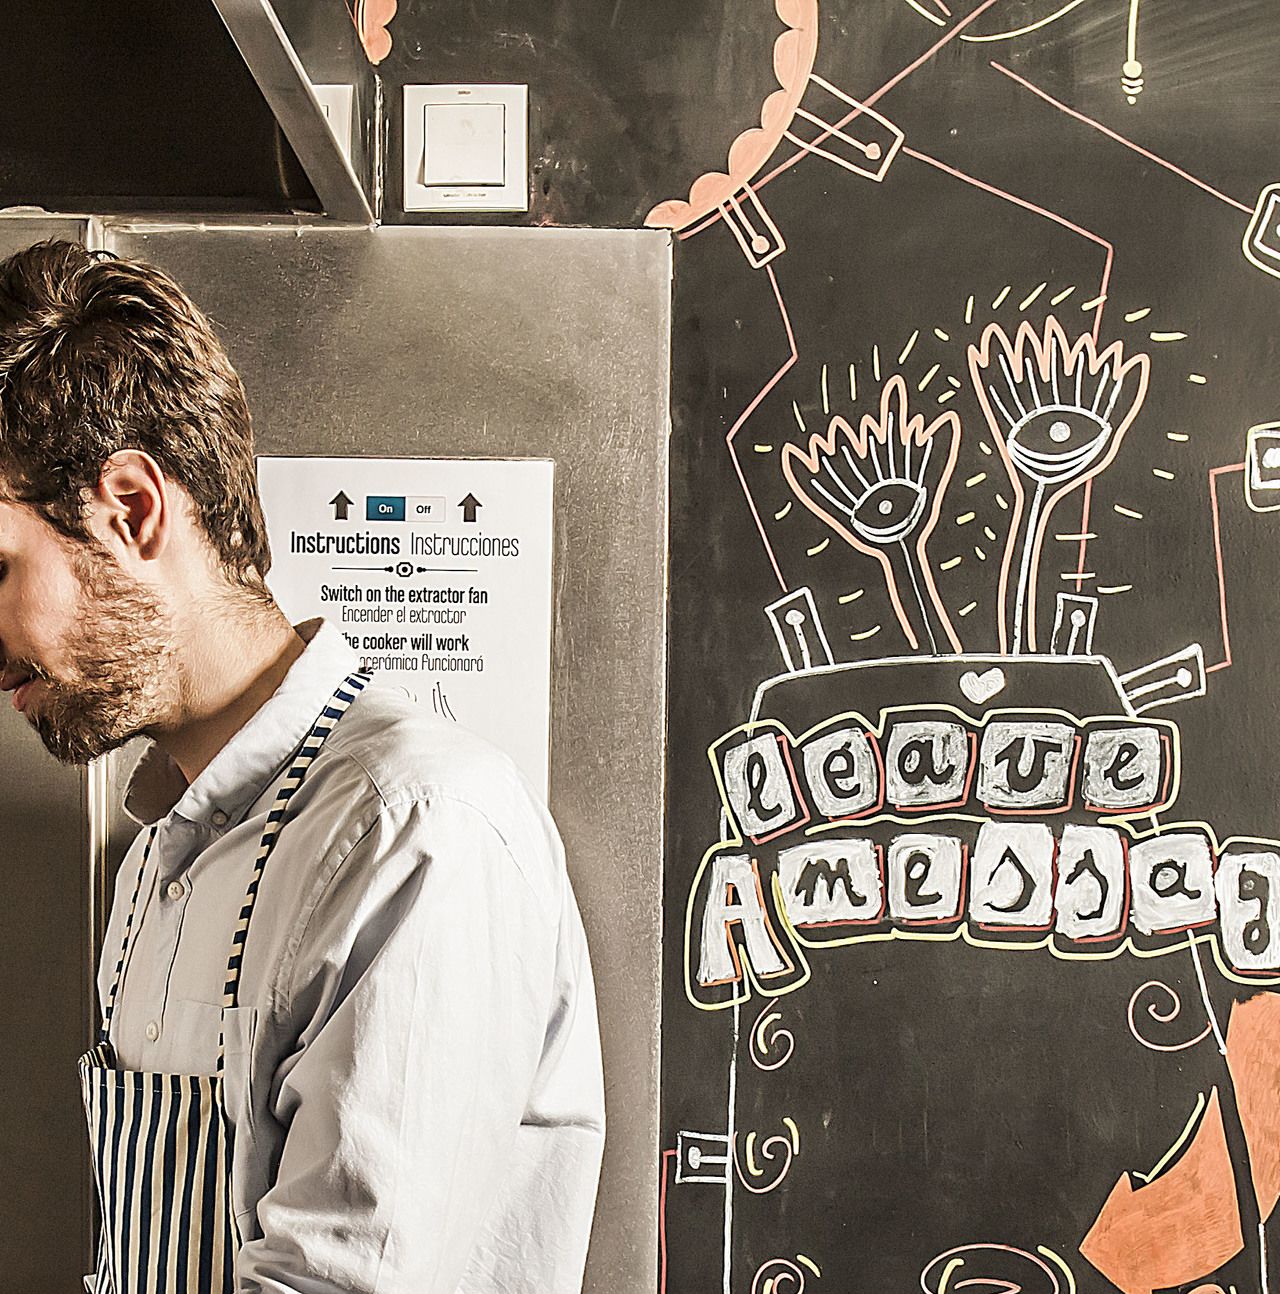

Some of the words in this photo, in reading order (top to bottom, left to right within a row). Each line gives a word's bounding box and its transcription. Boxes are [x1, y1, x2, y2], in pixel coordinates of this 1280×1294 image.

[378, 503, 394, 515] On
[416, 504, 432, 515] Off
[290, 531, 401, 555] Instructions
[411, 532, 520, 558] Instrucciones
[320, 585, 363, 602] Switch
[366, 589, 382, 602] on
[385, 587, 405, 603] the
[408, 588, 465, 604] extractor
[468, 588, 488, 604] fan
[342, 606, 393, 623] Encender
[396, 607, 406, 623] el
[410, 608, 467, 624] extractor
[342, 632, 360, 650] he
[362, 633, 408, 650] cooker
[410, 634, 433, 651] will
[435, 634, 470, 651] work
[421, 654, 484, 672] funcionará
[725, 720, 1172, 842] leave
